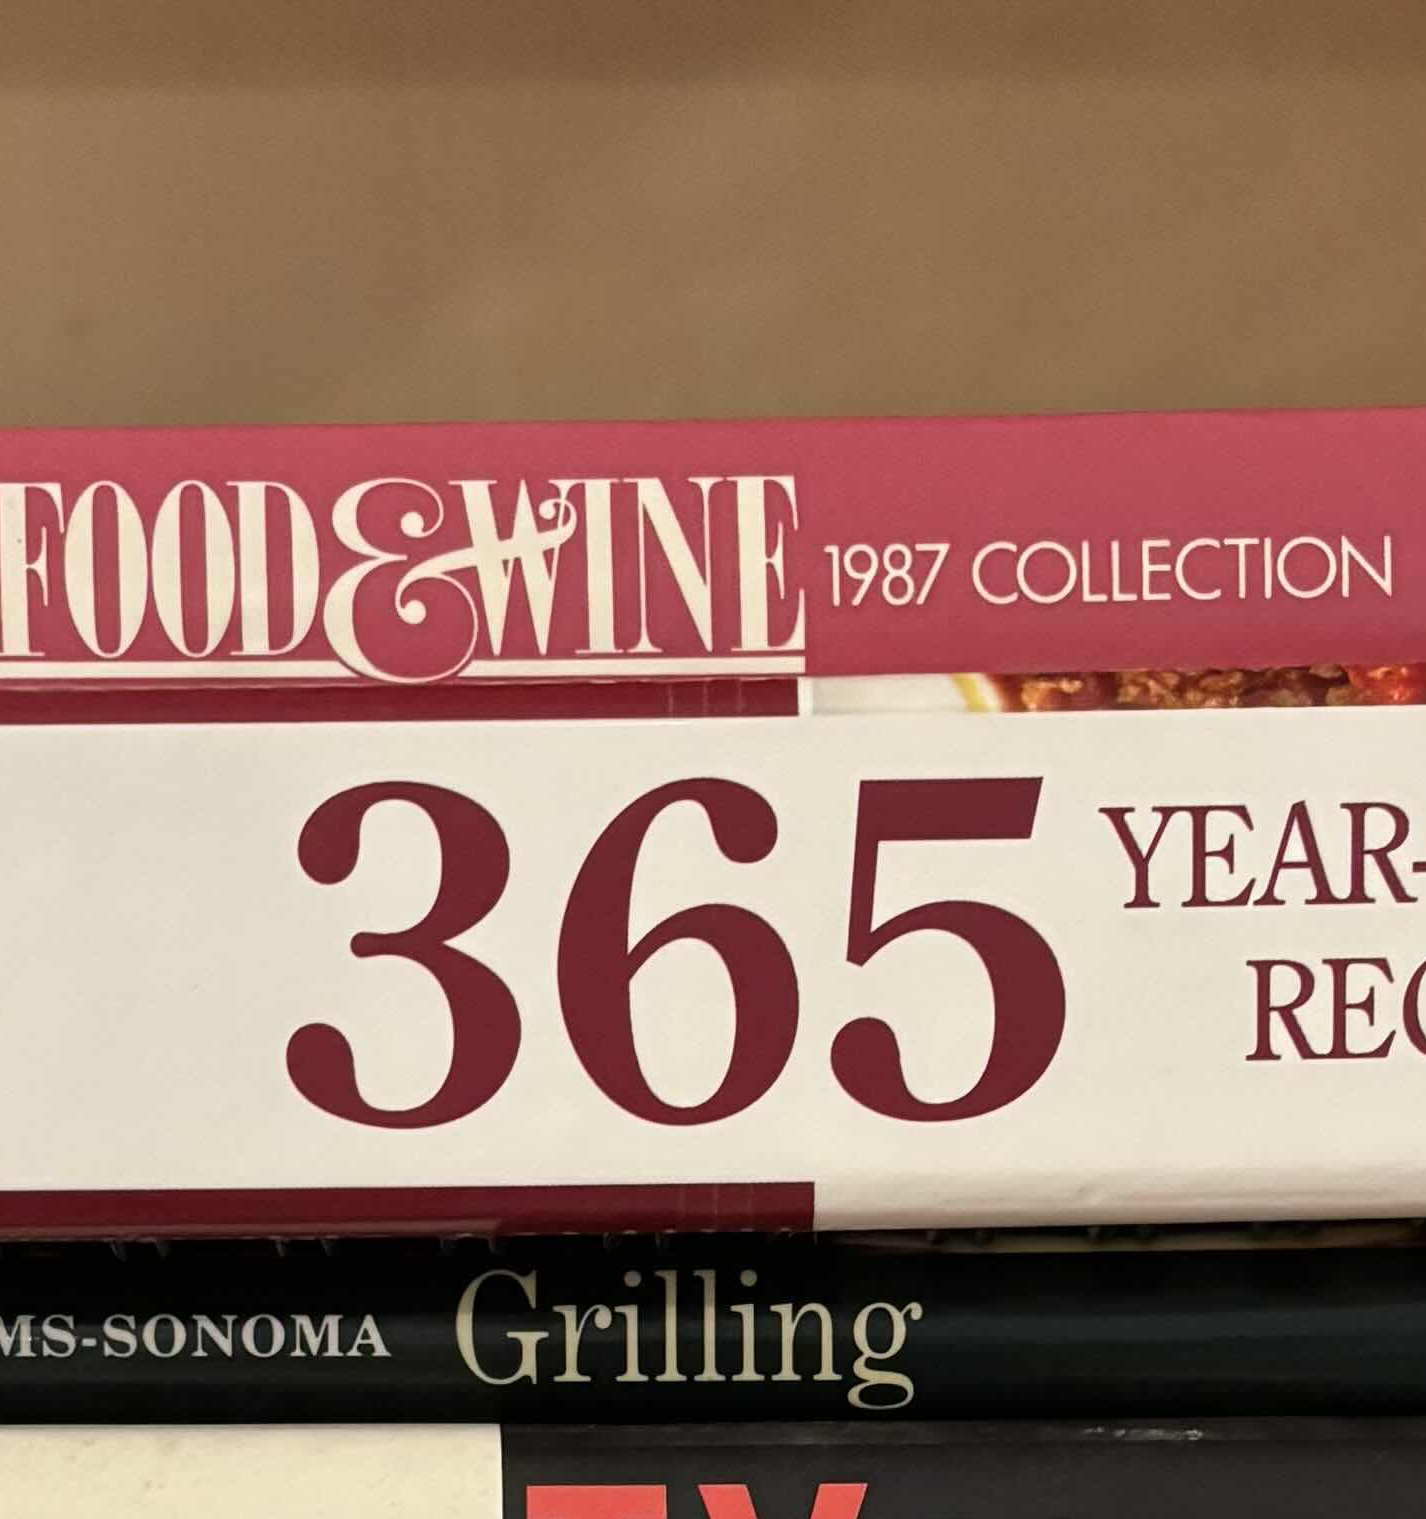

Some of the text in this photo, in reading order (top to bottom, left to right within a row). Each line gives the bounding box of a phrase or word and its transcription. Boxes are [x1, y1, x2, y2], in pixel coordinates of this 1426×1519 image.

[823, 542, 951, 607] 1987
[972, 534, 1394, 605] COLLECTION
[285, 776, 1067, 1129] 365
[455, 1268, 923, 1410] Grilling
